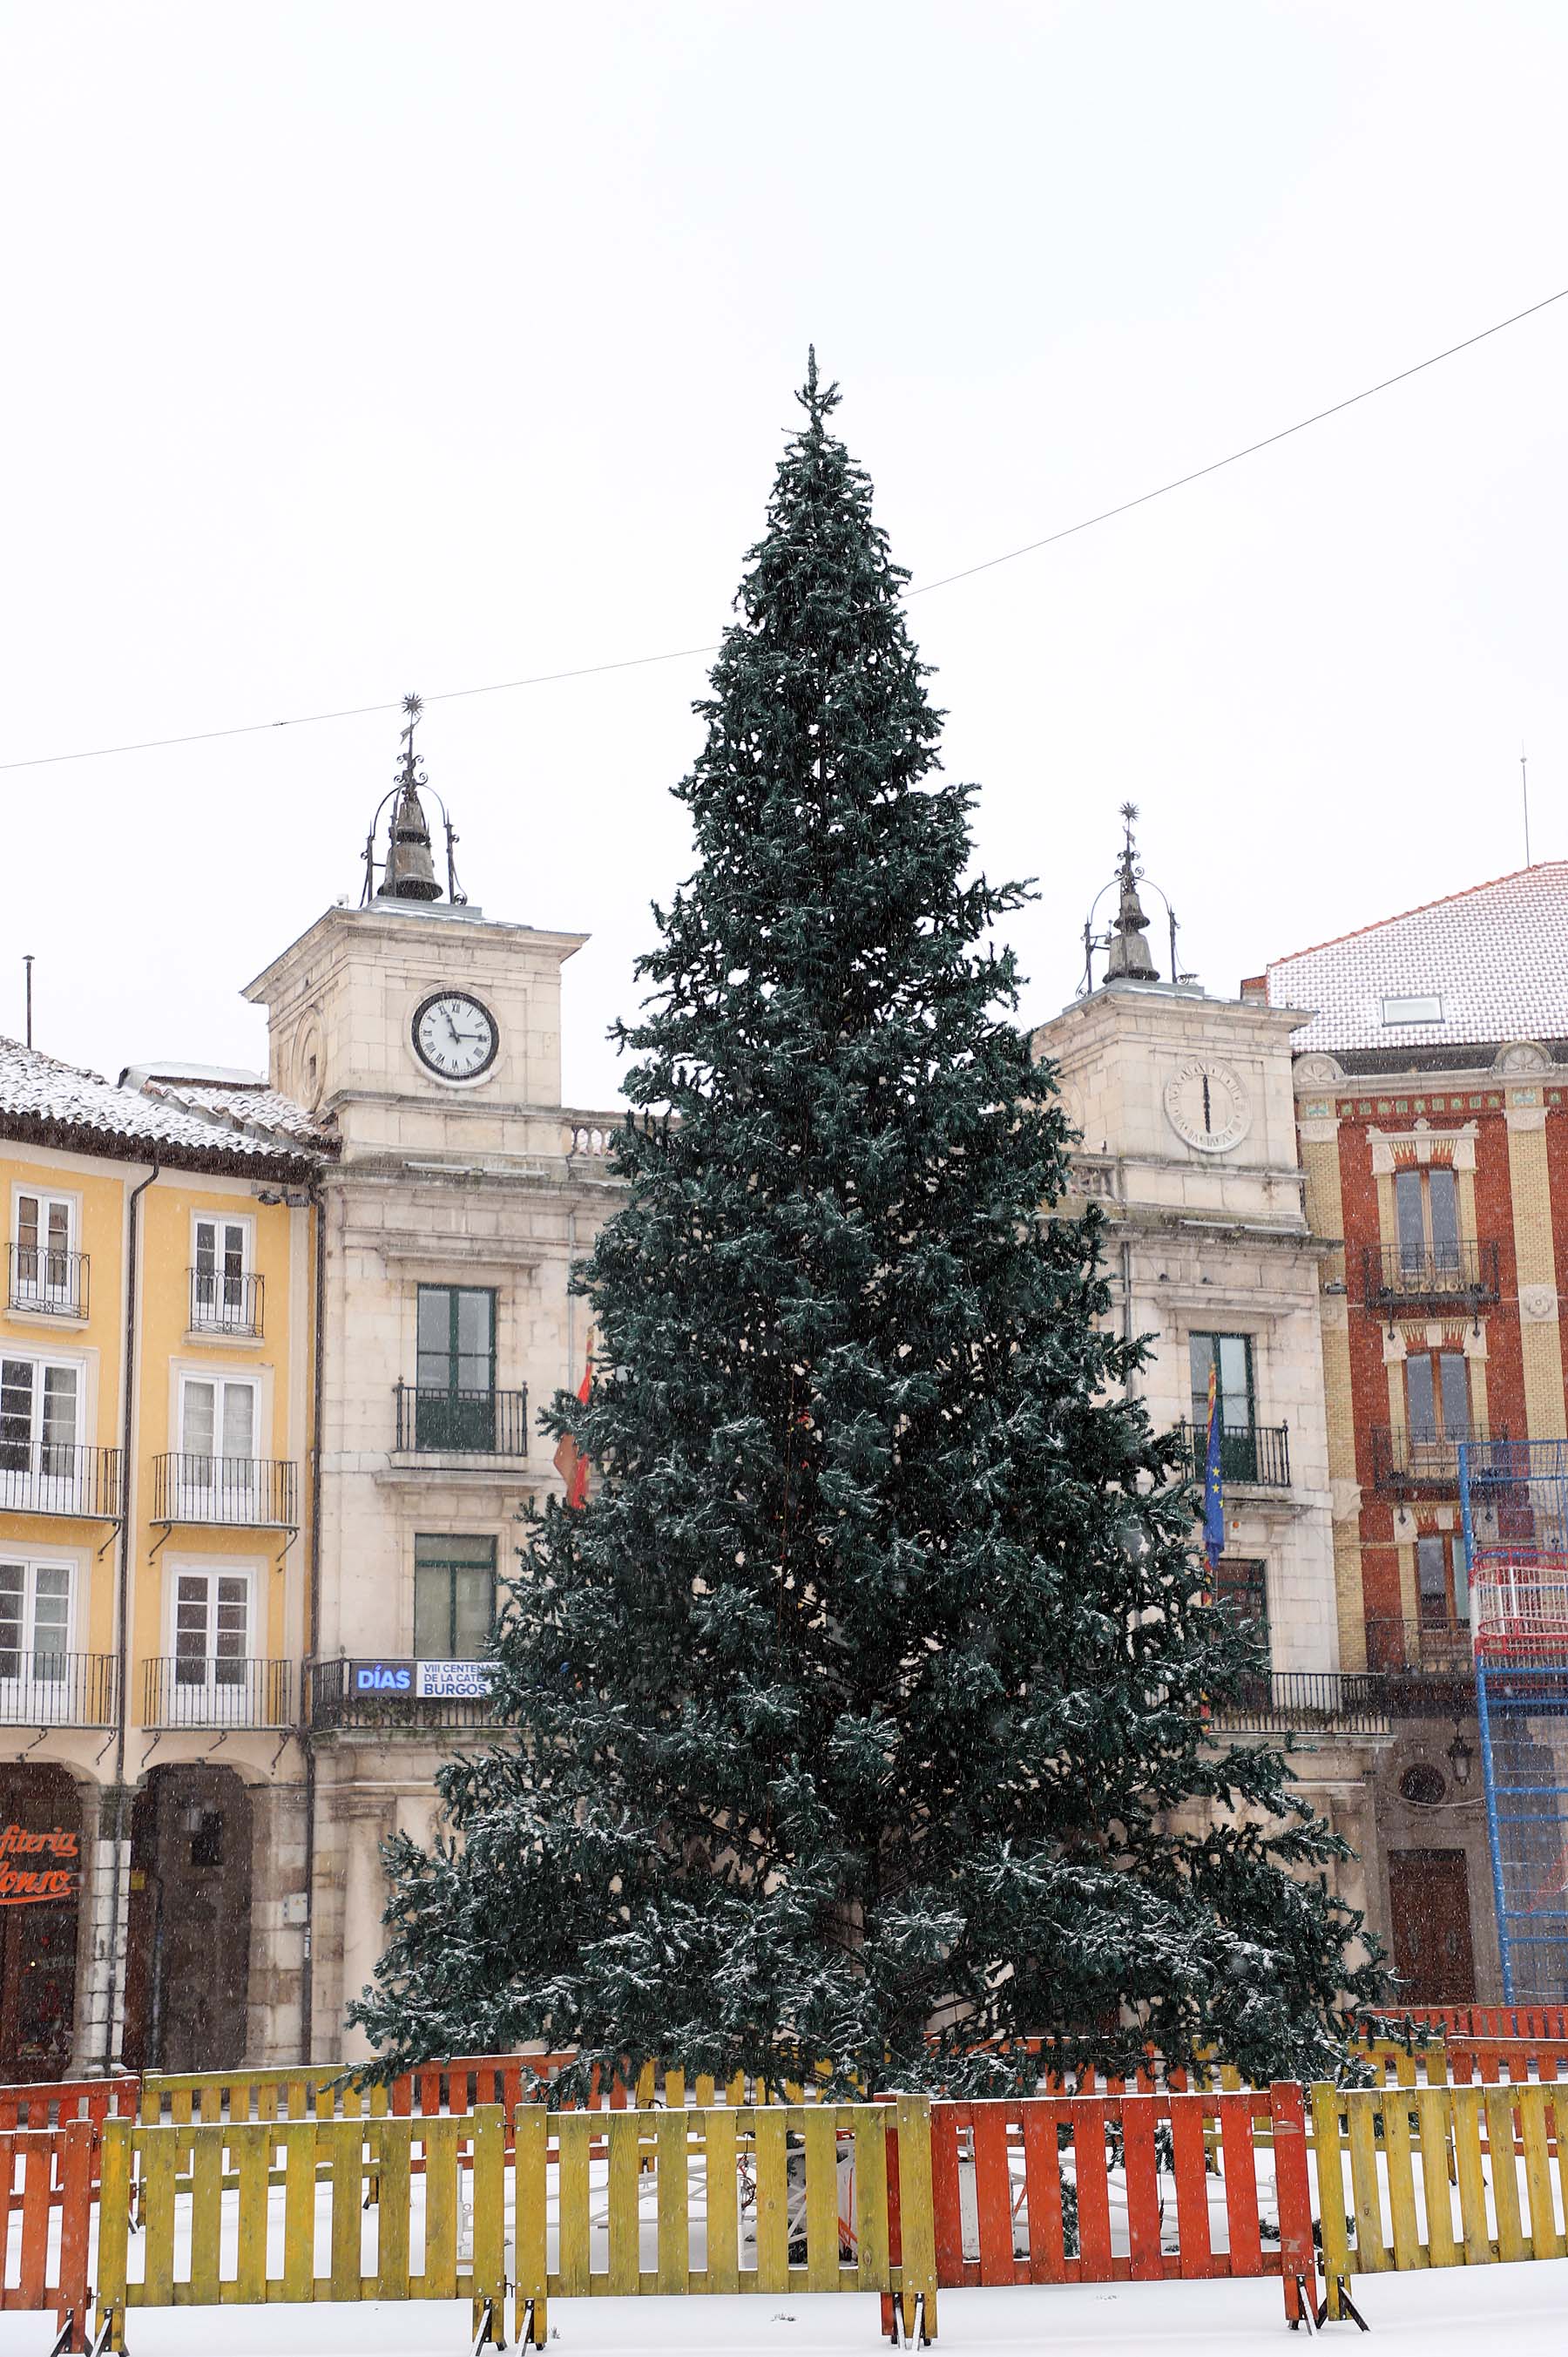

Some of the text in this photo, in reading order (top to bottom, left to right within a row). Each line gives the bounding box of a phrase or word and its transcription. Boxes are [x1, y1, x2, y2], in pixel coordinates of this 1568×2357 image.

[424, 1664, 440, 1673] VIII
[358, 1664, 411, 1690] DÍAS
[424, 1674, 437, 1683] DE
[441, 1674, 453, 1683] LA
[424, 1683, 486, 1695] BURGOS
